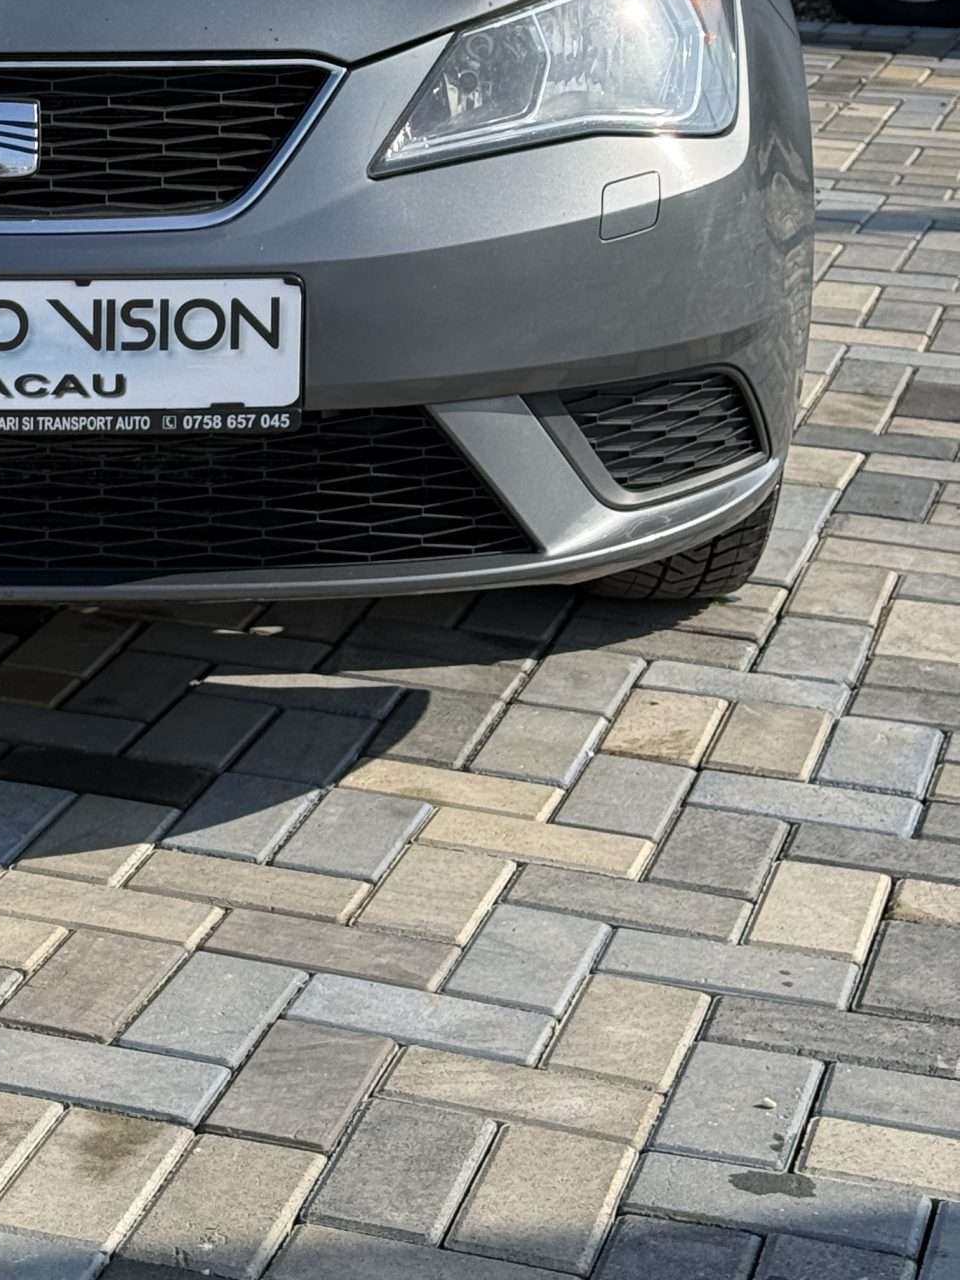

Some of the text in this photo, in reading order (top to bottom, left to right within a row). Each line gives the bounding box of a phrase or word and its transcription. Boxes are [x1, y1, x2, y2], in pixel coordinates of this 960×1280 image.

[46, 297, 280, 352] VISION
[22, 416, 34, 431] SI
[37, 416, 113, 431] TRANSPORT
[117, 416, 151, 431] AUTO
[183, 415, 222, 430] 0758
[228, 415, 256, 429] 657
[261, 414, 290, 429] 045
